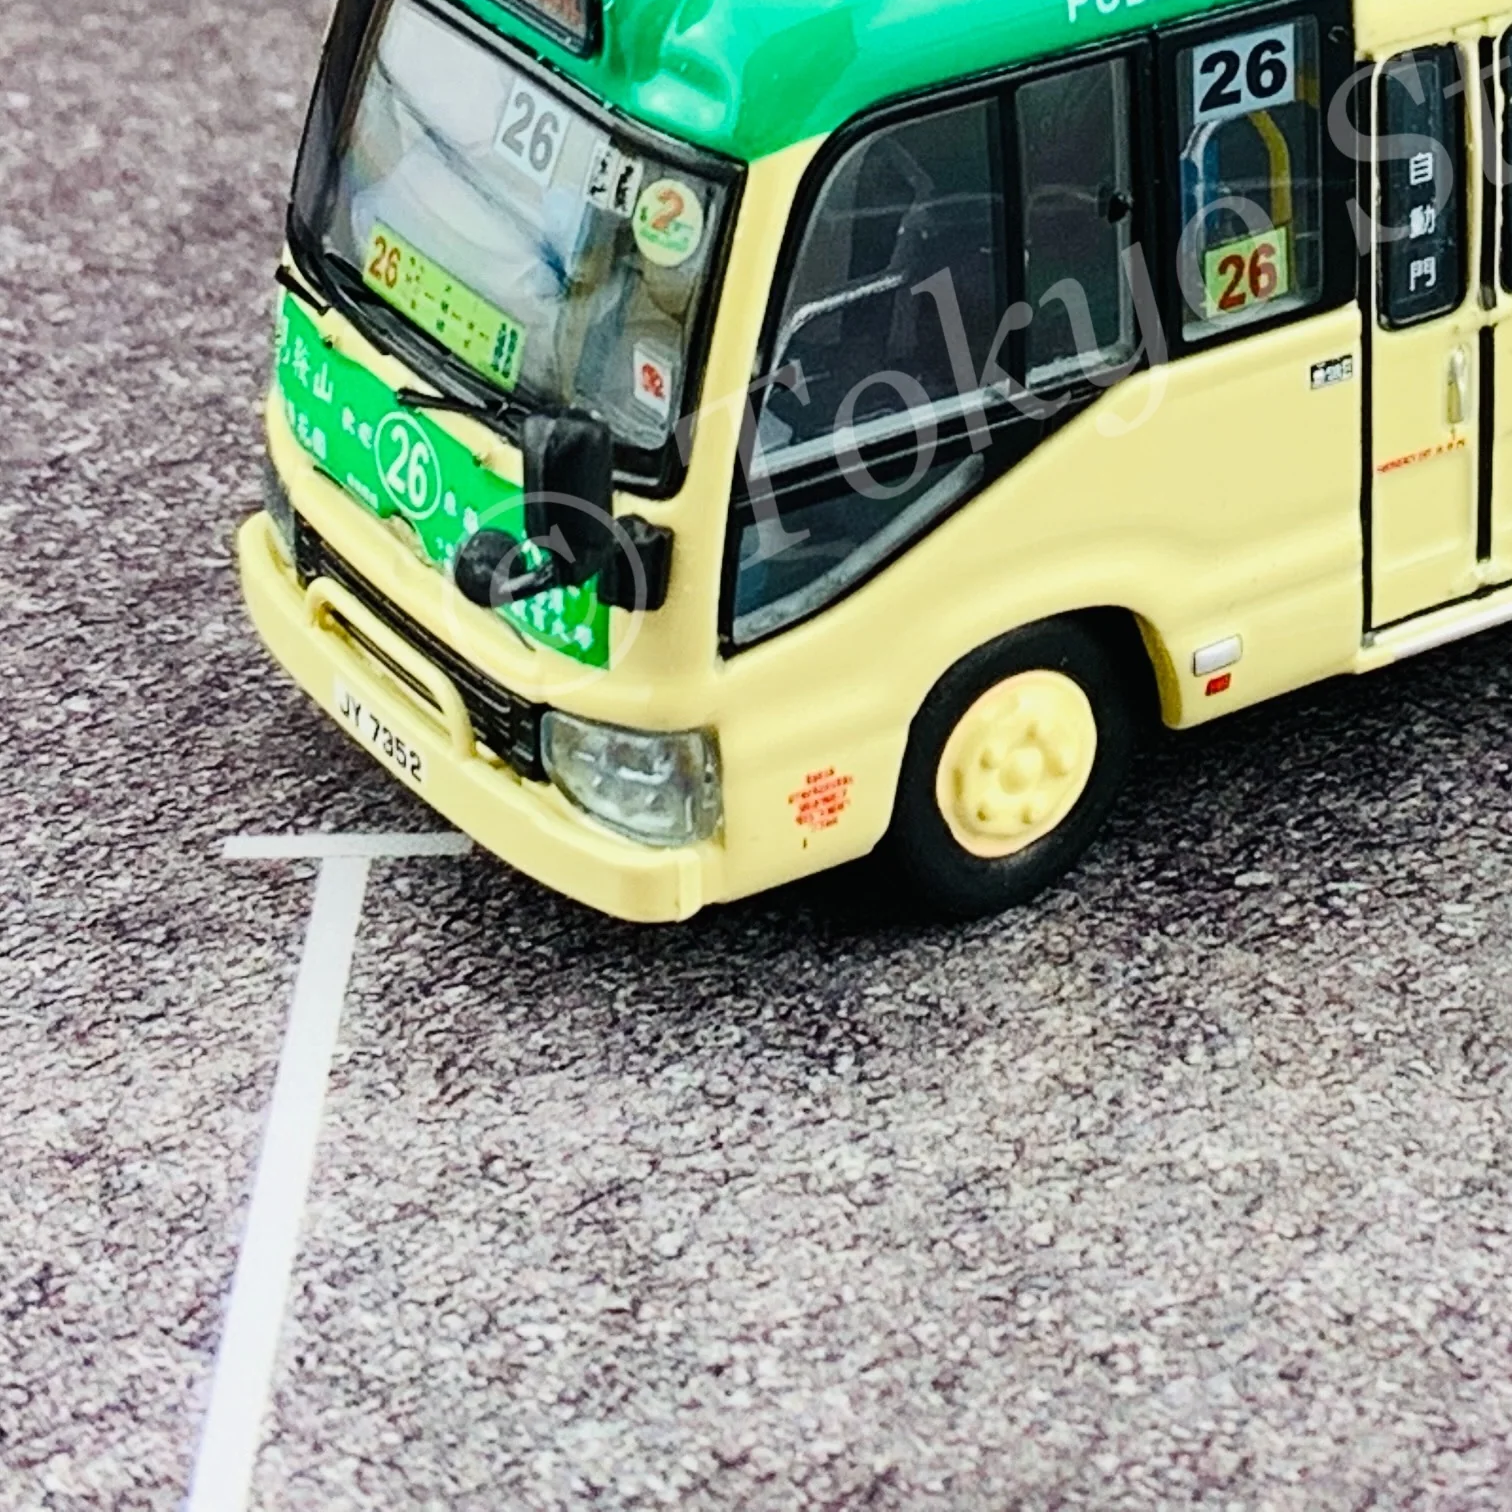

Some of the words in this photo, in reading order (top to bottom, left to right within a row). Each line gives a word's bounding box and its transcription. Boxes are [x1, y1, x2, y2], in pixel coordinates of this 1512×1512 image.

[1197, 38, 1288, 113] 26
[500, 89, 560, 174] 26
[368, 235, 401, 289] 26
[1408, 151, 1437, 292] 自動門
[1217, 241, 1279, 314] 26
[386, 424, 430, 508] 26
[340, 691, 361, 728] JY
[369, 714, 422, 783] 7352
